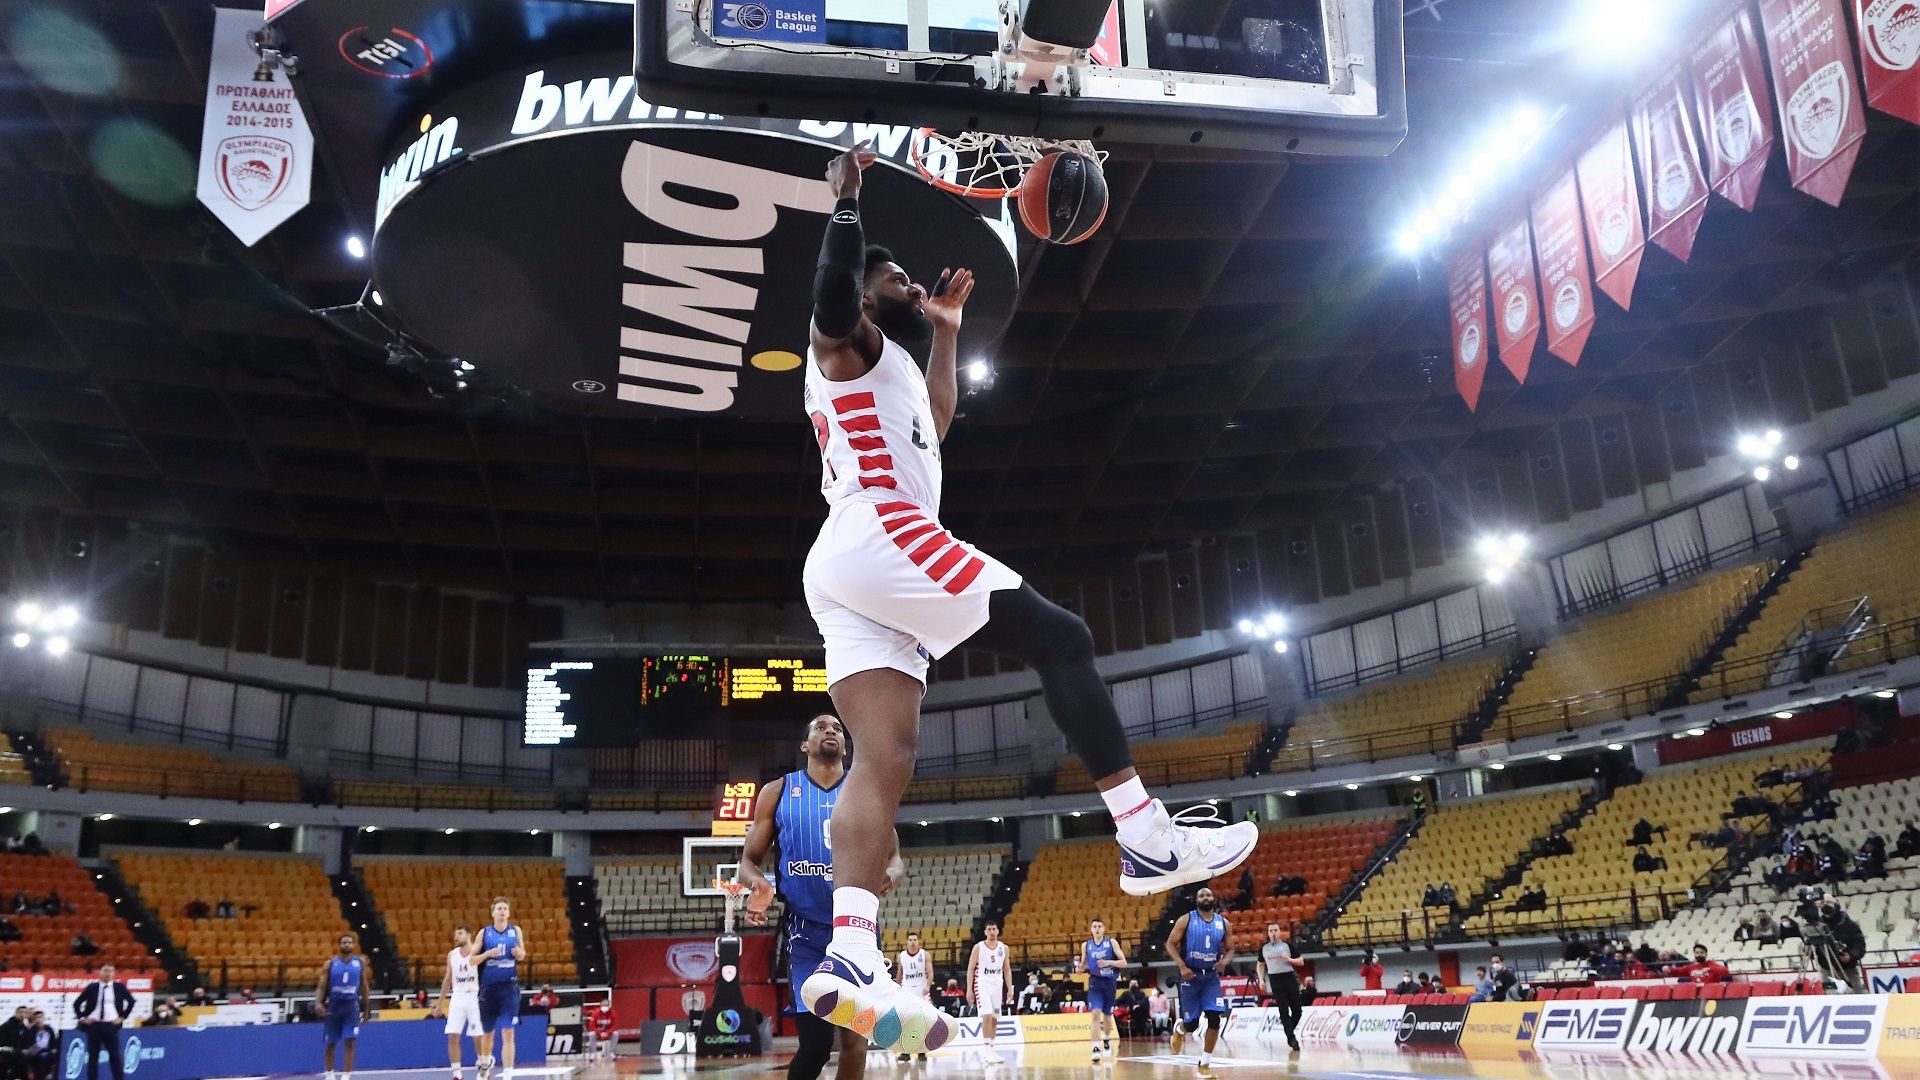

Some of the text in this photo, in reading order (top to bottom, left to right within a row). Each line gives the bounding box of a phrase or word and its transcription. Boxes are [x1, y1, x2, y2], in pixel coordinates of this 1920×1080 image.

[775, 9, 817, 22] Basket
[775, 20, 817, 33] League
[232, 101, 291, 113] ΕΛΛΑΔΟΣ
[511, 69, 706, 135] bw
[226, 115, 293, 128] 2014-2015
[798, 119, 958, 184] wn
[616, 140, 837, 412] bwin
[1731, 725, 1772, 747] LEGENDS
[724, 782, 755, 798] 6:30
[719, 798, 751, 819] 20
[905, 972, 924, 980] bwin
[1416, 1021, 1441, 1031] NEVER
[1442, 1021, 1462, 1032] QUIT
[1541, 1007, 1627, 1039] FMS
[1627, 999, 1738, 1051] bwin
[1746, 1004, 1878, 1045] FMS
